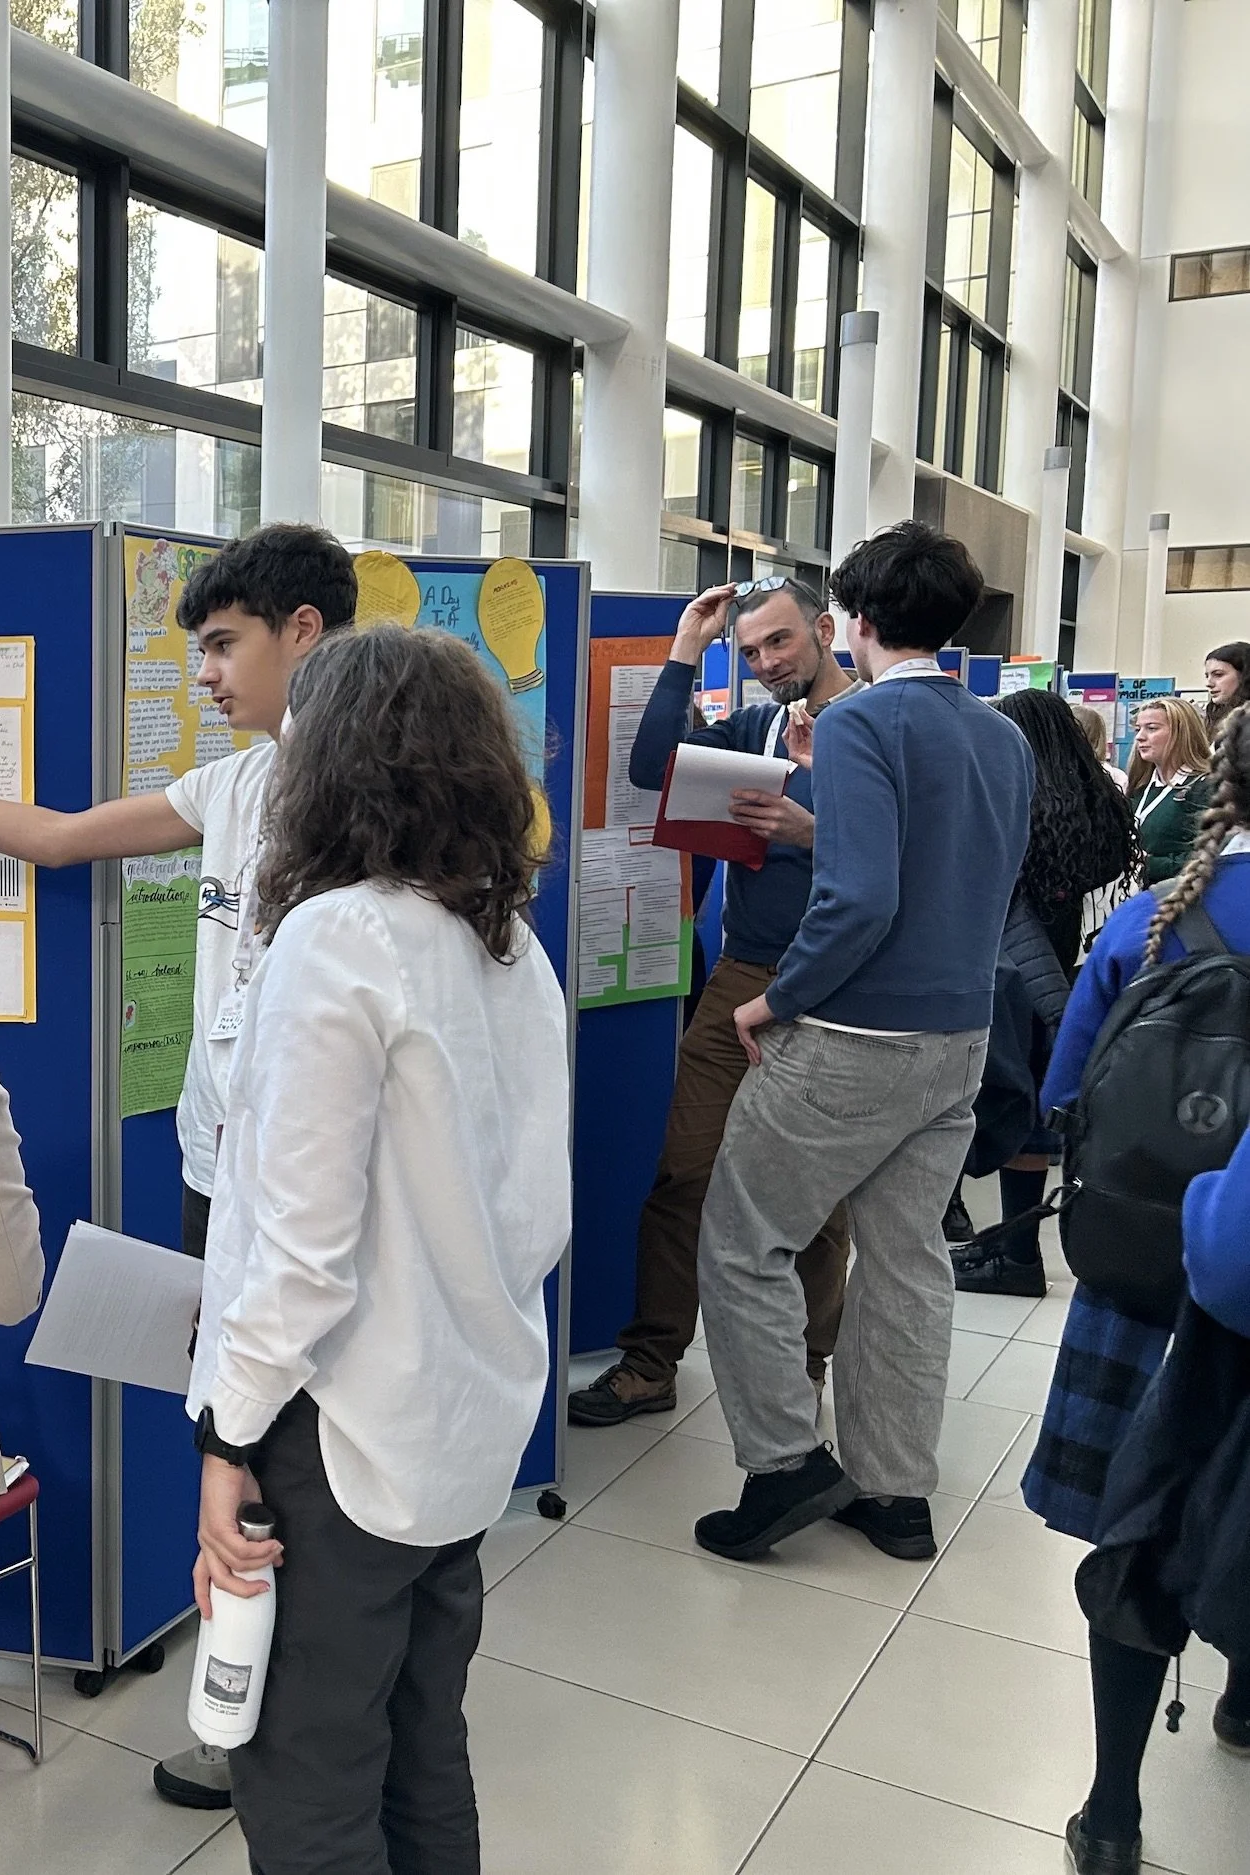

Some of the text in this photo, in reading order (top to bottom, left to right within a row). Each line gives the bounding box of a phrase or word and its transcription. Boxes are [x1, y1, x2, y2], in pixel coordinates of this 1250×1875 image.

[424, 585, 436, 606] A
[441, 586, 460, 612] Day
[432, 608, 460, 628] In A
